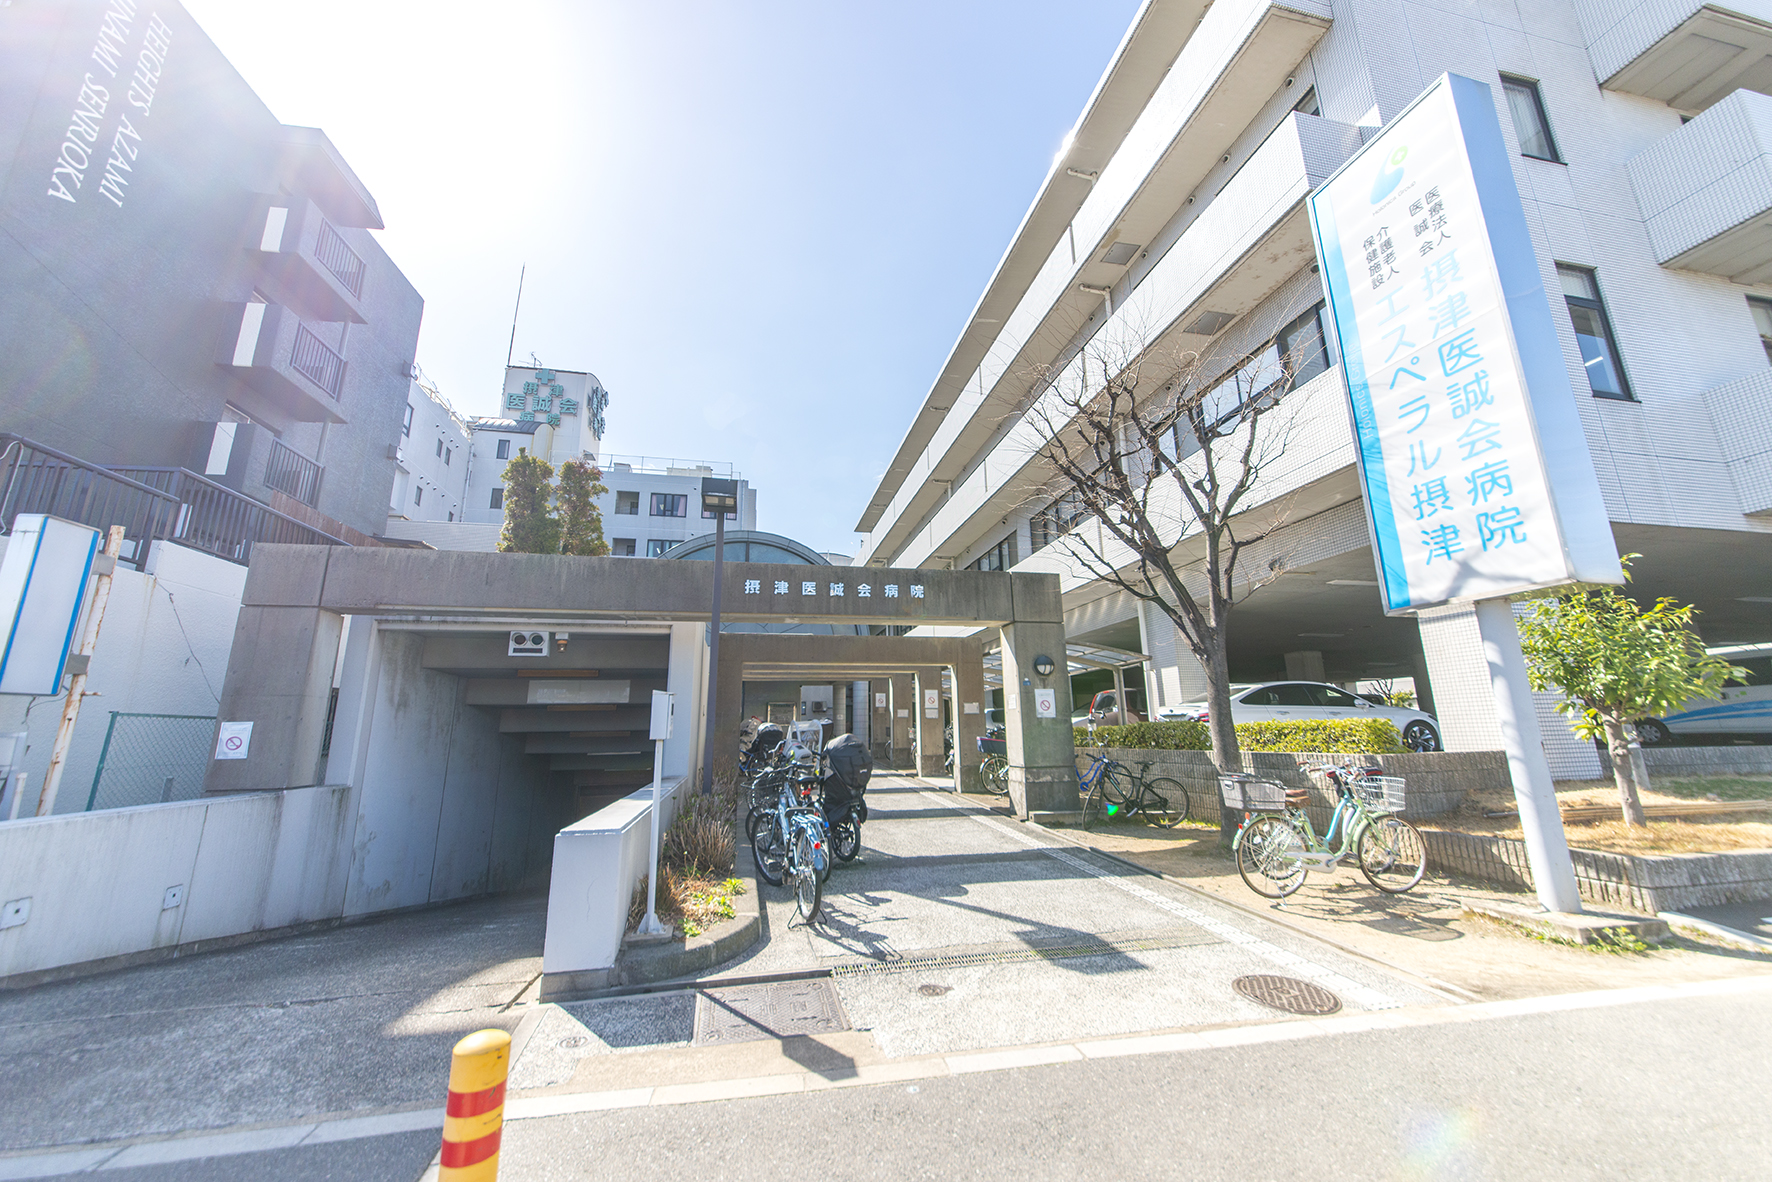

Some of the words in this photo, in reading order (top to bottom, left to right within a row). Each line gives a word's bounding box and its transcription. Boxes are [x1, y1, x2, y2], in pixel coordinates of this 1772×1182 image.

[92, 0, 138, 78] INAMI
[128, 12, 173, 117] HEIGHTS
[48, 72, 110, 203] SENRIOKA
[99, 113, 142, 208] AZAMI
[1408, 198, 1434, 257] 医誠会
[1425, 185, 1451, 246] 医療法人
[1363, 235, 1385, 290] 保健施設
[1376, 226, 1400, 281] 介護老人
[506, 393, 578, 415] 医誠会
[523, 381, 564, 397] 摂津
[1421, 247, 1527, 552] 摂津医誠会病院
[1376, 286, 1464, 566] エスペラル摂津
[744, 579, 925, 599] 摂津医誠会病院
